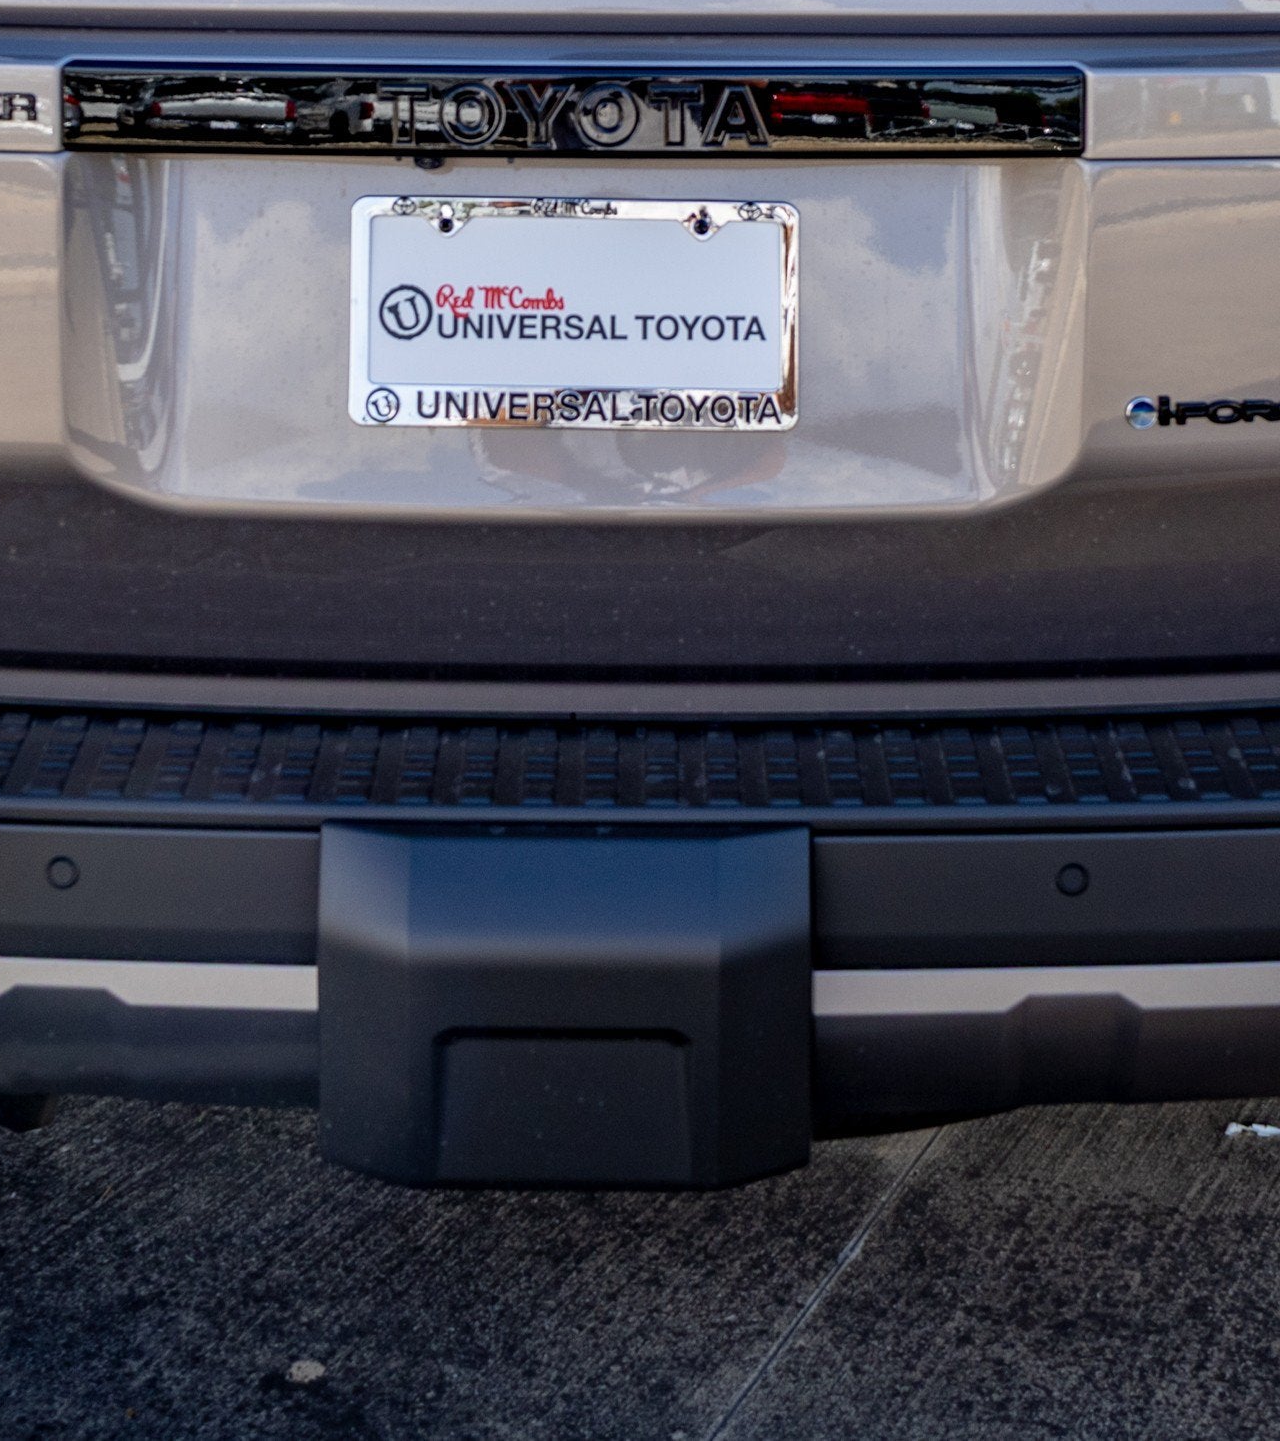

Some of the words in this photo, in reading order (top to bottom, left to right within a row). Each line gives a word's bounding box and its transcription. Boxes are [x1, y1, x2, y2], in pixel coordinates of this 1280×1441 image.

[377, 81, 772, 149] TOYOTA
[436, 284, 475, 318] Red
[436, 314, 628, 340] UNIVERSAL
[635, 315, 767, 341] TOYOTA
[417, 390, 631, 422] UNIVERSAL
[637, 392, 782, 424] TOYOTA
